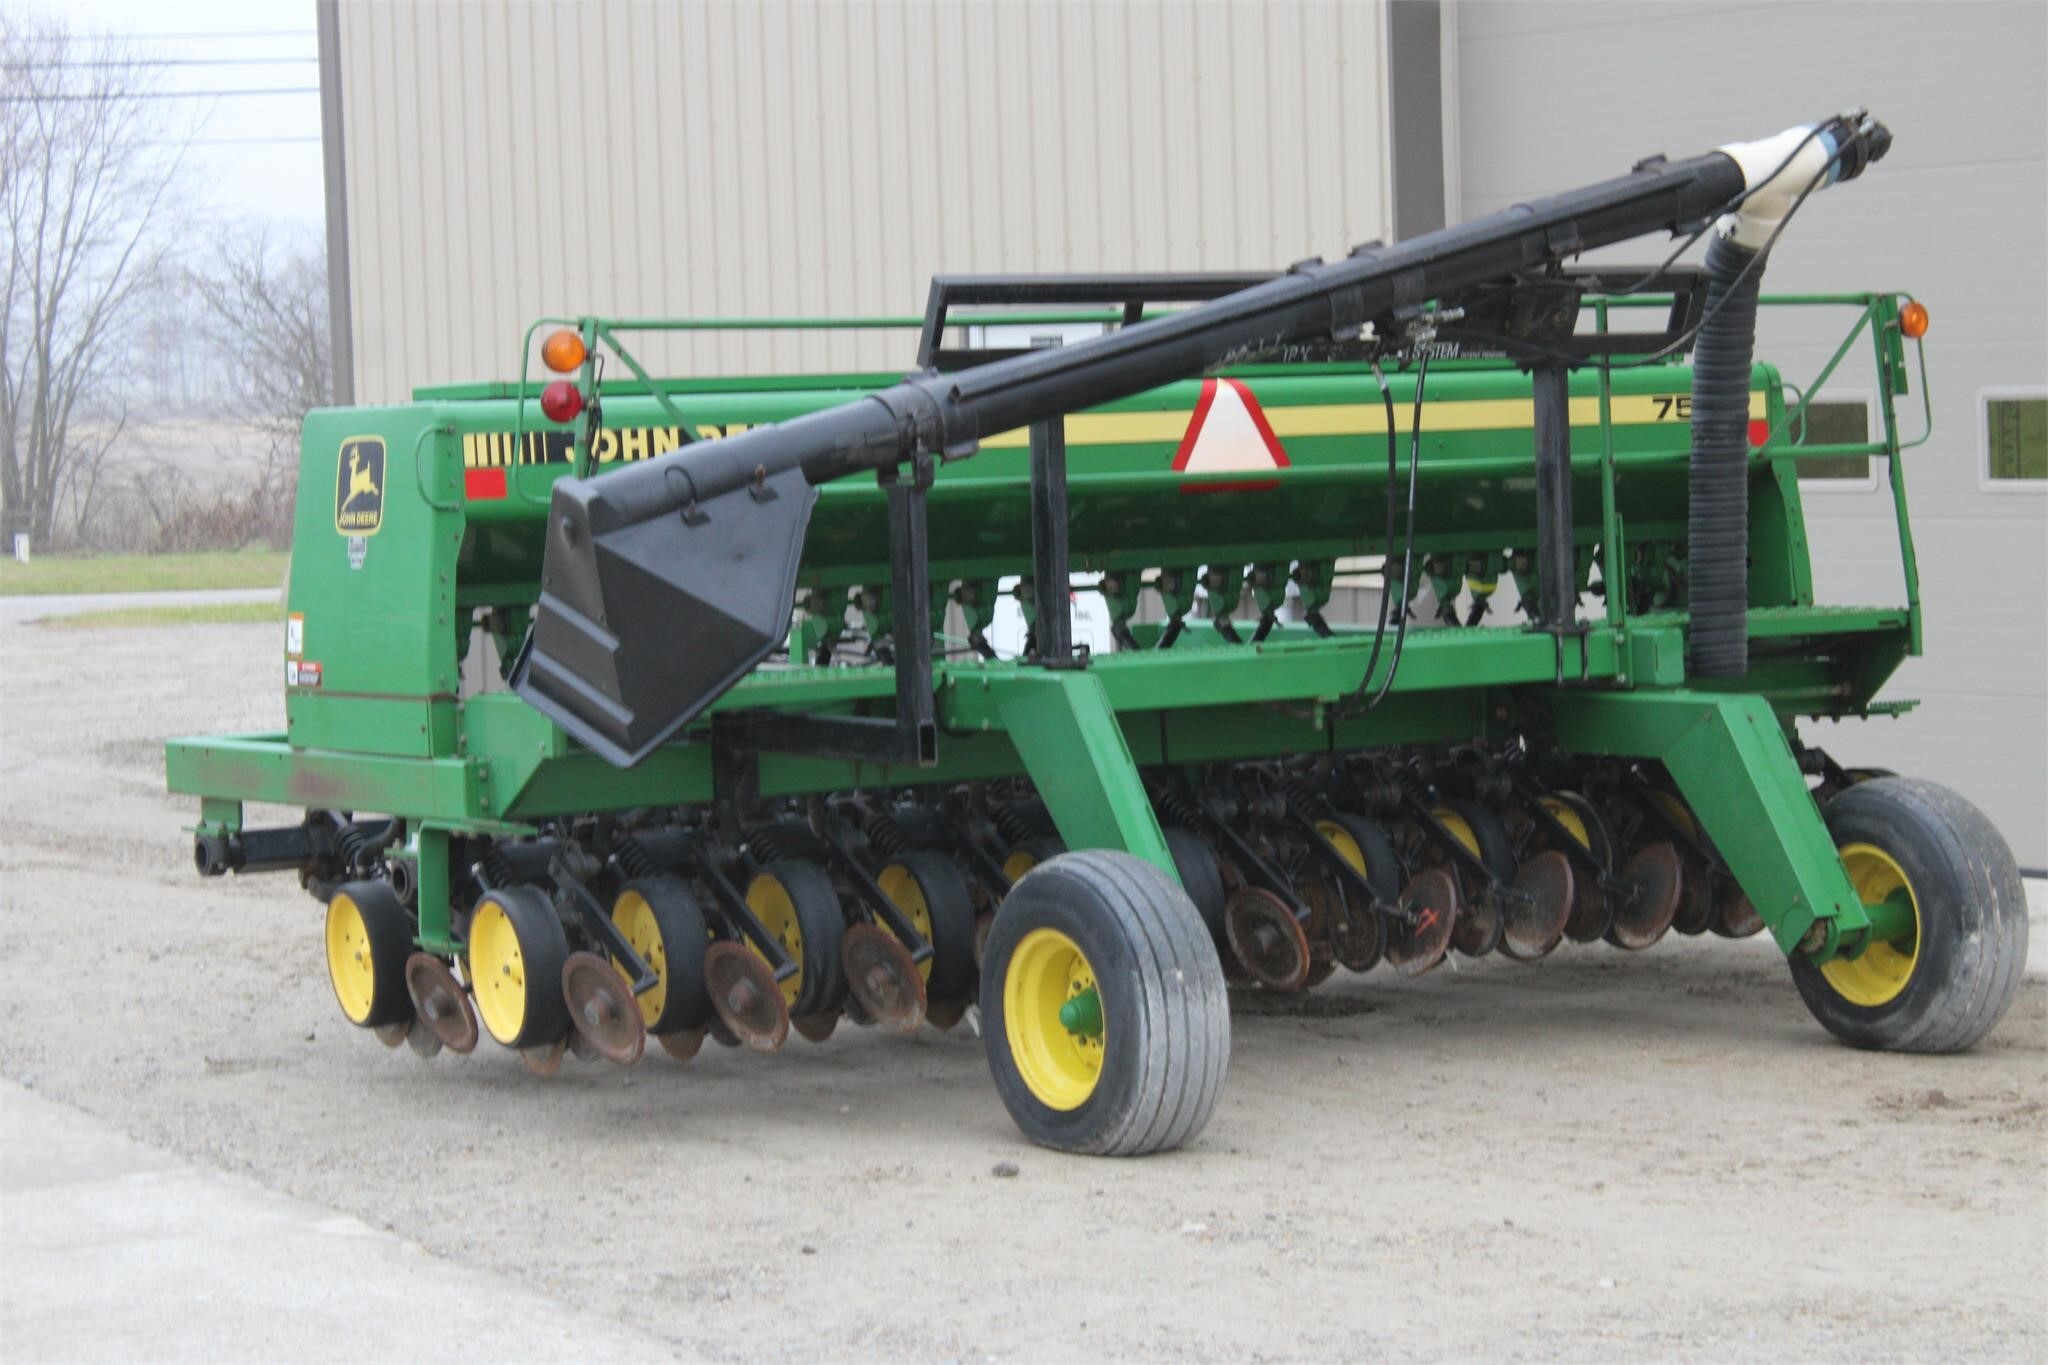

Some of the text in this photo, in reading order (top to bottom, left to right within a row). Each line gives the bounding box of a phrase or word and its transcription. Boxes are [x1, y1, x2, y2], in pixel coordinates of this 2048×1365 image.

[1652, 397, 1692, 422] 75
[339, 510, 378, 528] JOHN DEERE
